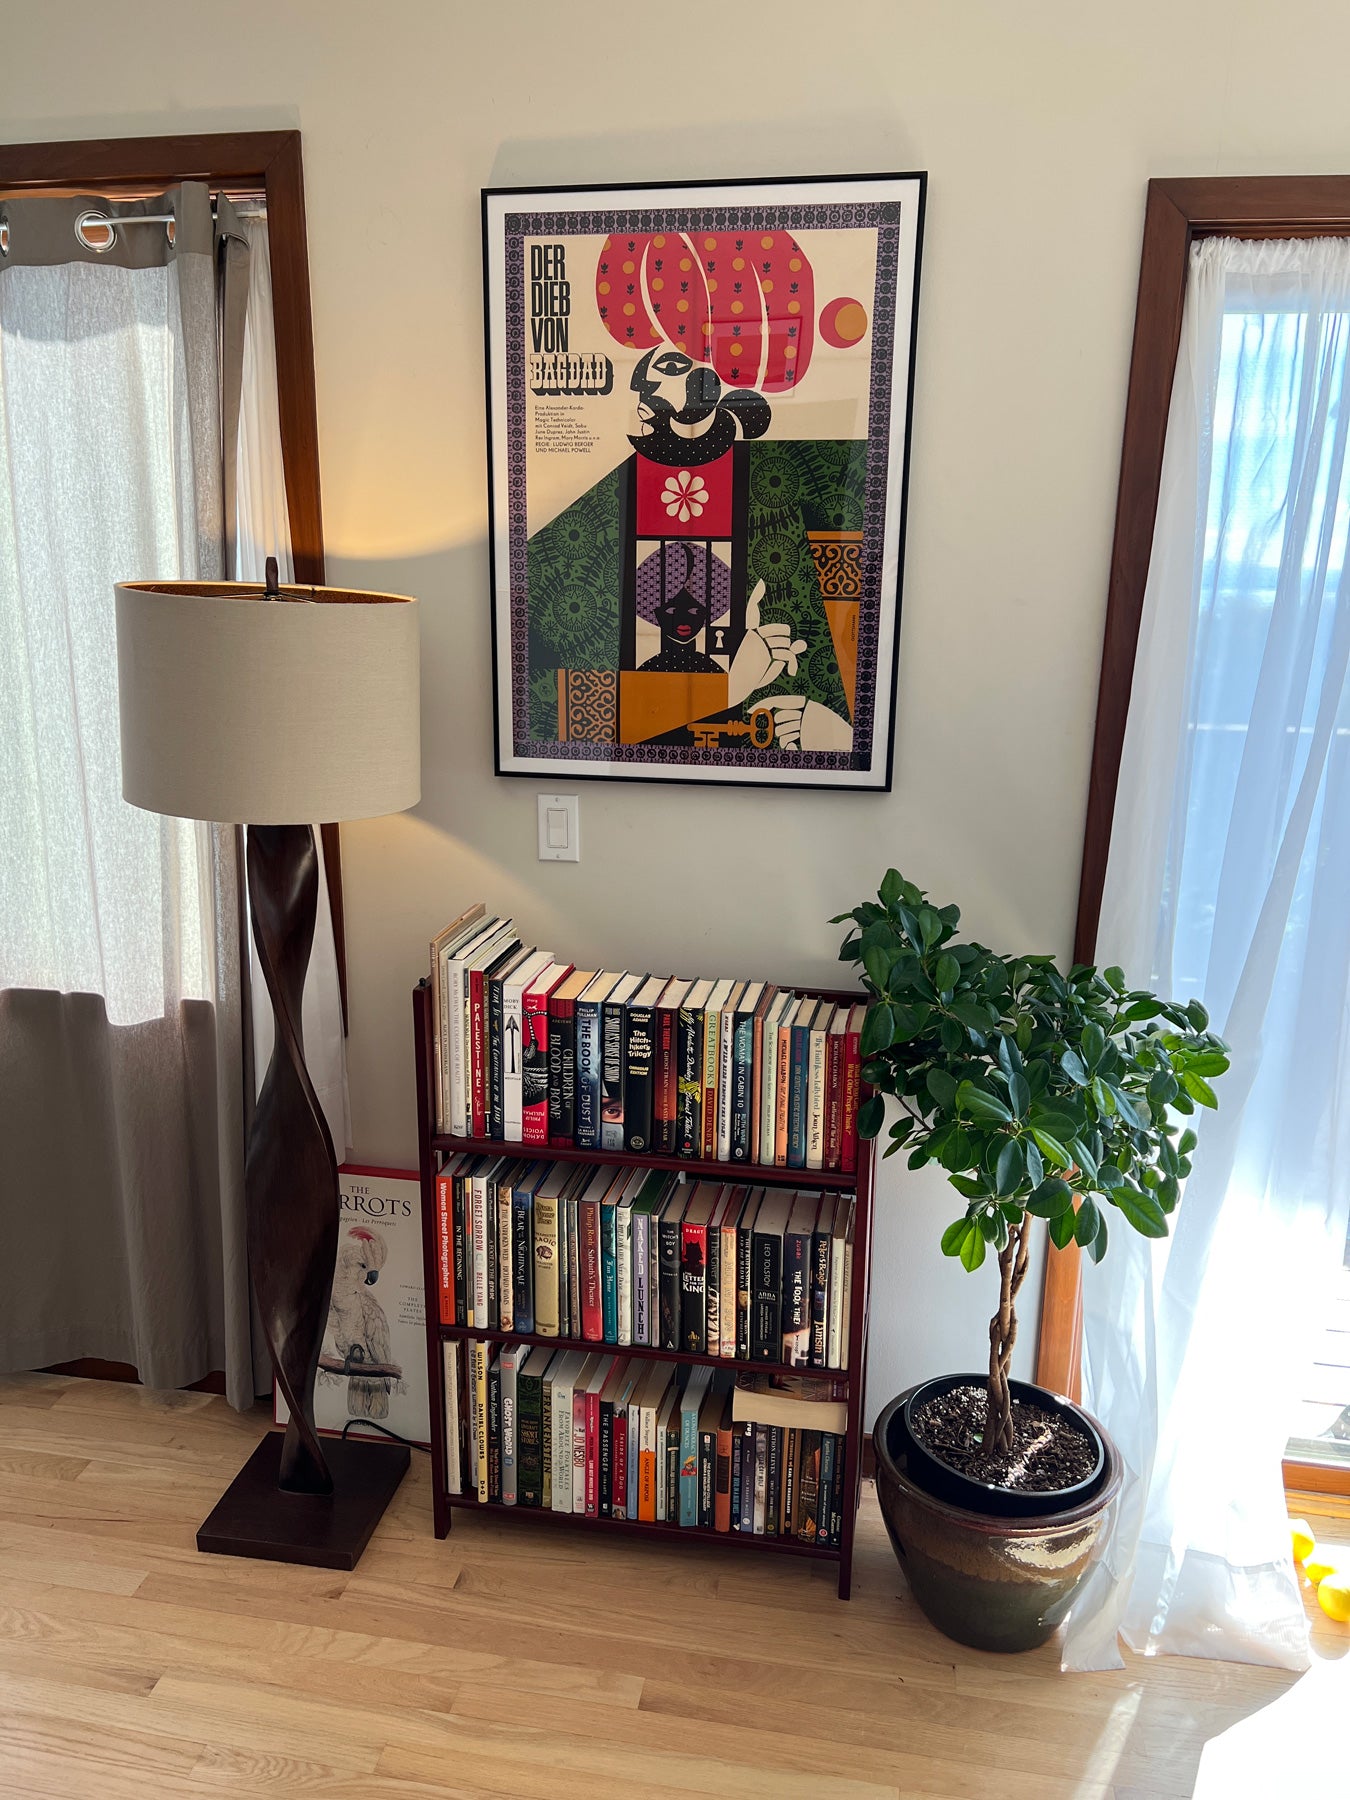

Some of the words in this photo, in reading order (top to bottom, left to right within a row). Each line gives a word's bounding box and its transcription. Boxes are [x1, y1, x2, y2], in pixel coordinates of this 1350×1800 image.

[530, 244, 566, 280] DER
[531, 280, 570, 318] DIEB
[530, 318, 568, 353] VON
[530, 353, 614, 396] BAGDAD
[581, 1019, 591, 1038] THE
[663, 1014, 671, 1027] PAUL
[738, 1021, 746, 1035] THE
[474, 1002, 482, 1087] PALESTINE
[604, 1042, 620, 1057] SENSE
[663, 1028, 671, 1050] THEROUX
[687, 1026, 695, 1054] Absolute
[550, 1034, 561, 1073] BLOOD
[581, 1042, 591, 1074] BOOK
[628, 1050, 651, 1058] Trilogy
[562, 1048, 574, 1100] CHILDREN
[604, 1065, 620, 1083] SNOW
[684, 1055, 694, 1082] Darling
[581, 1077, 591, 1090] OF
[493, 1105, 502, 1123] BIRDS
[550, 1087, 561, 1120] BONE
[581, 1095, 592, 1123] DUST
[684, 1092, 692, 1115] Gabriel
[684, 1116, 692, 1139] Tallent
[811, 1113, 819, 1130] Joan
[811, 1131, 820, 1150] Aiken
[350, 1186, 370, 1194] THE
[340, 1194, 412, 1217] RROTS
[586, 1207, 594, 1228] Philip
[711, 1241, 719, 1255] The
[441, 1235, 450, 1288] Photographers
[517, 1240, 526, 1286] NIGHTINGALE
[711, 1257, 719, 1279] Giver
[817, 1263, 827, 1286] Beagle
[814, 1320, 824, 1354] Tamsin
[503, 1398, 513, 1426] GHOST
[504, 1428, 513, 1455] WORLD
